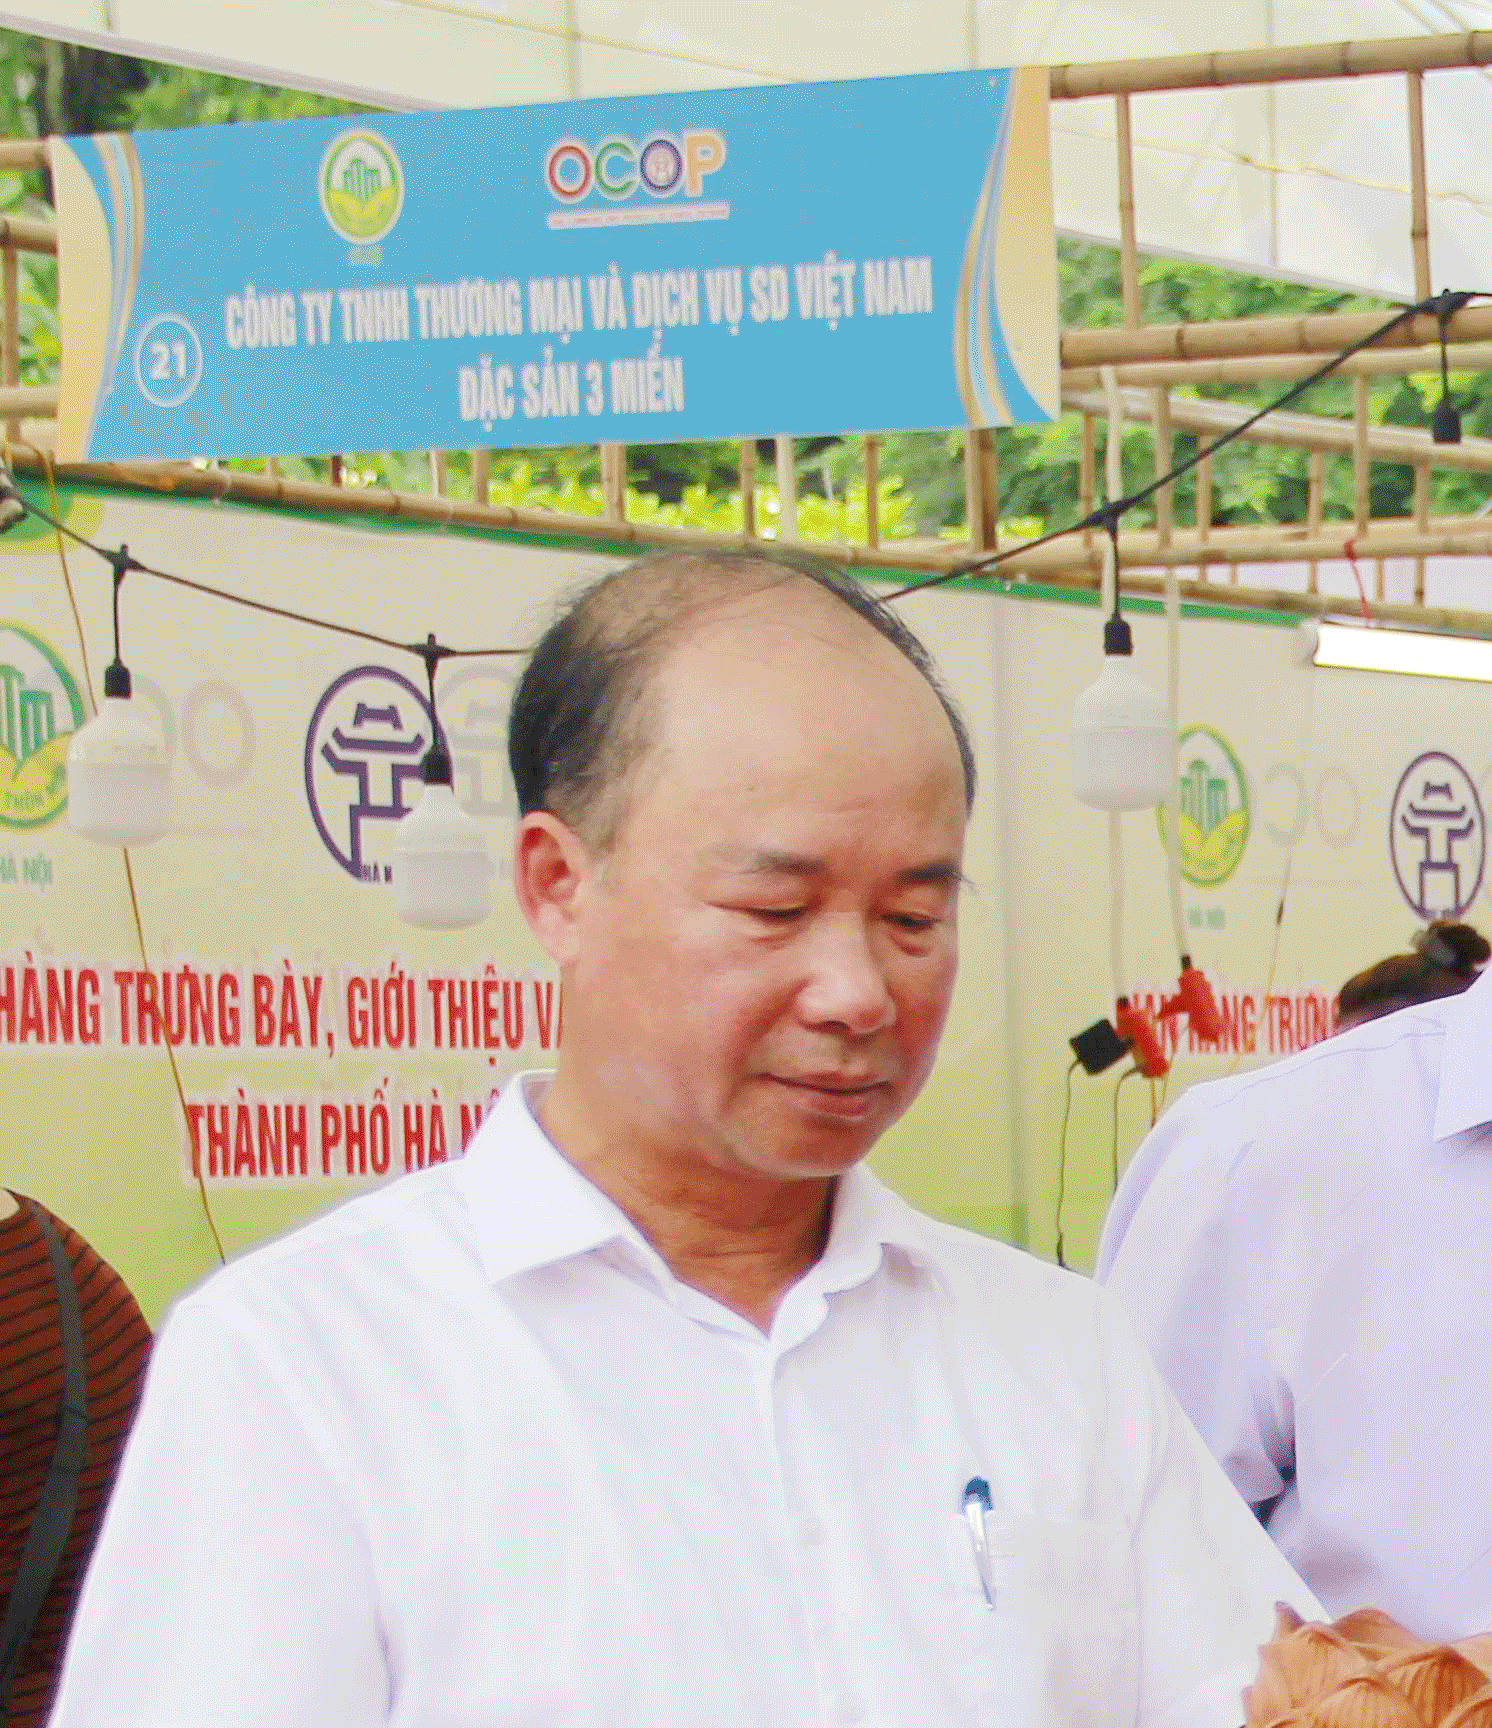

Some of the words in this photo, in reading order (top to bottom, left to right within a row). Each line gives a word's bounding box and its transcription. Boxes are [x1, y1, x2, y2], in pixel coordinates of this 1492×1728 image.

[547, 132, 726, 201] OCOP
[226, 281, 297, 349] CÔNG
[302, 289, 333, 346] TY
[338, 284, 409, 343] TNHH
[414, 277, 523, 339] THƯƠNG
[527, 276, 584, 344] MẠI
[588, 261, 627, 330] VÀ
[631, 268, 699, 340] DỊCH
[703, 266, 743, 336] VỤ
[795, 250, 856, 331] VIỆT
[862, 257, 933, 316] NAM
[149, 341, 188, 380] 21
[457, 354, 515, 432] ĐẶC
[521, 345, 580, 419] SẢN
[585, 361, 604, 416] 3
[609, 340, 685, 415] MIỀN
[0, 950, 101, 1045] HÀNG
[114, 964, 241, 1047] TRƯNG
[253, 958, 335, 1059] BÀY,
[347, 961, 417, 1049] GIỚI
[427, 963, 525, 1067] THIỆU
[534, 980, 563, 1050] V
[185, 1087, 308, 1179] THÀNH
[321, 1077, 391, 1176] PHỐ
[403, 1088, 449, 1174] HÀ
